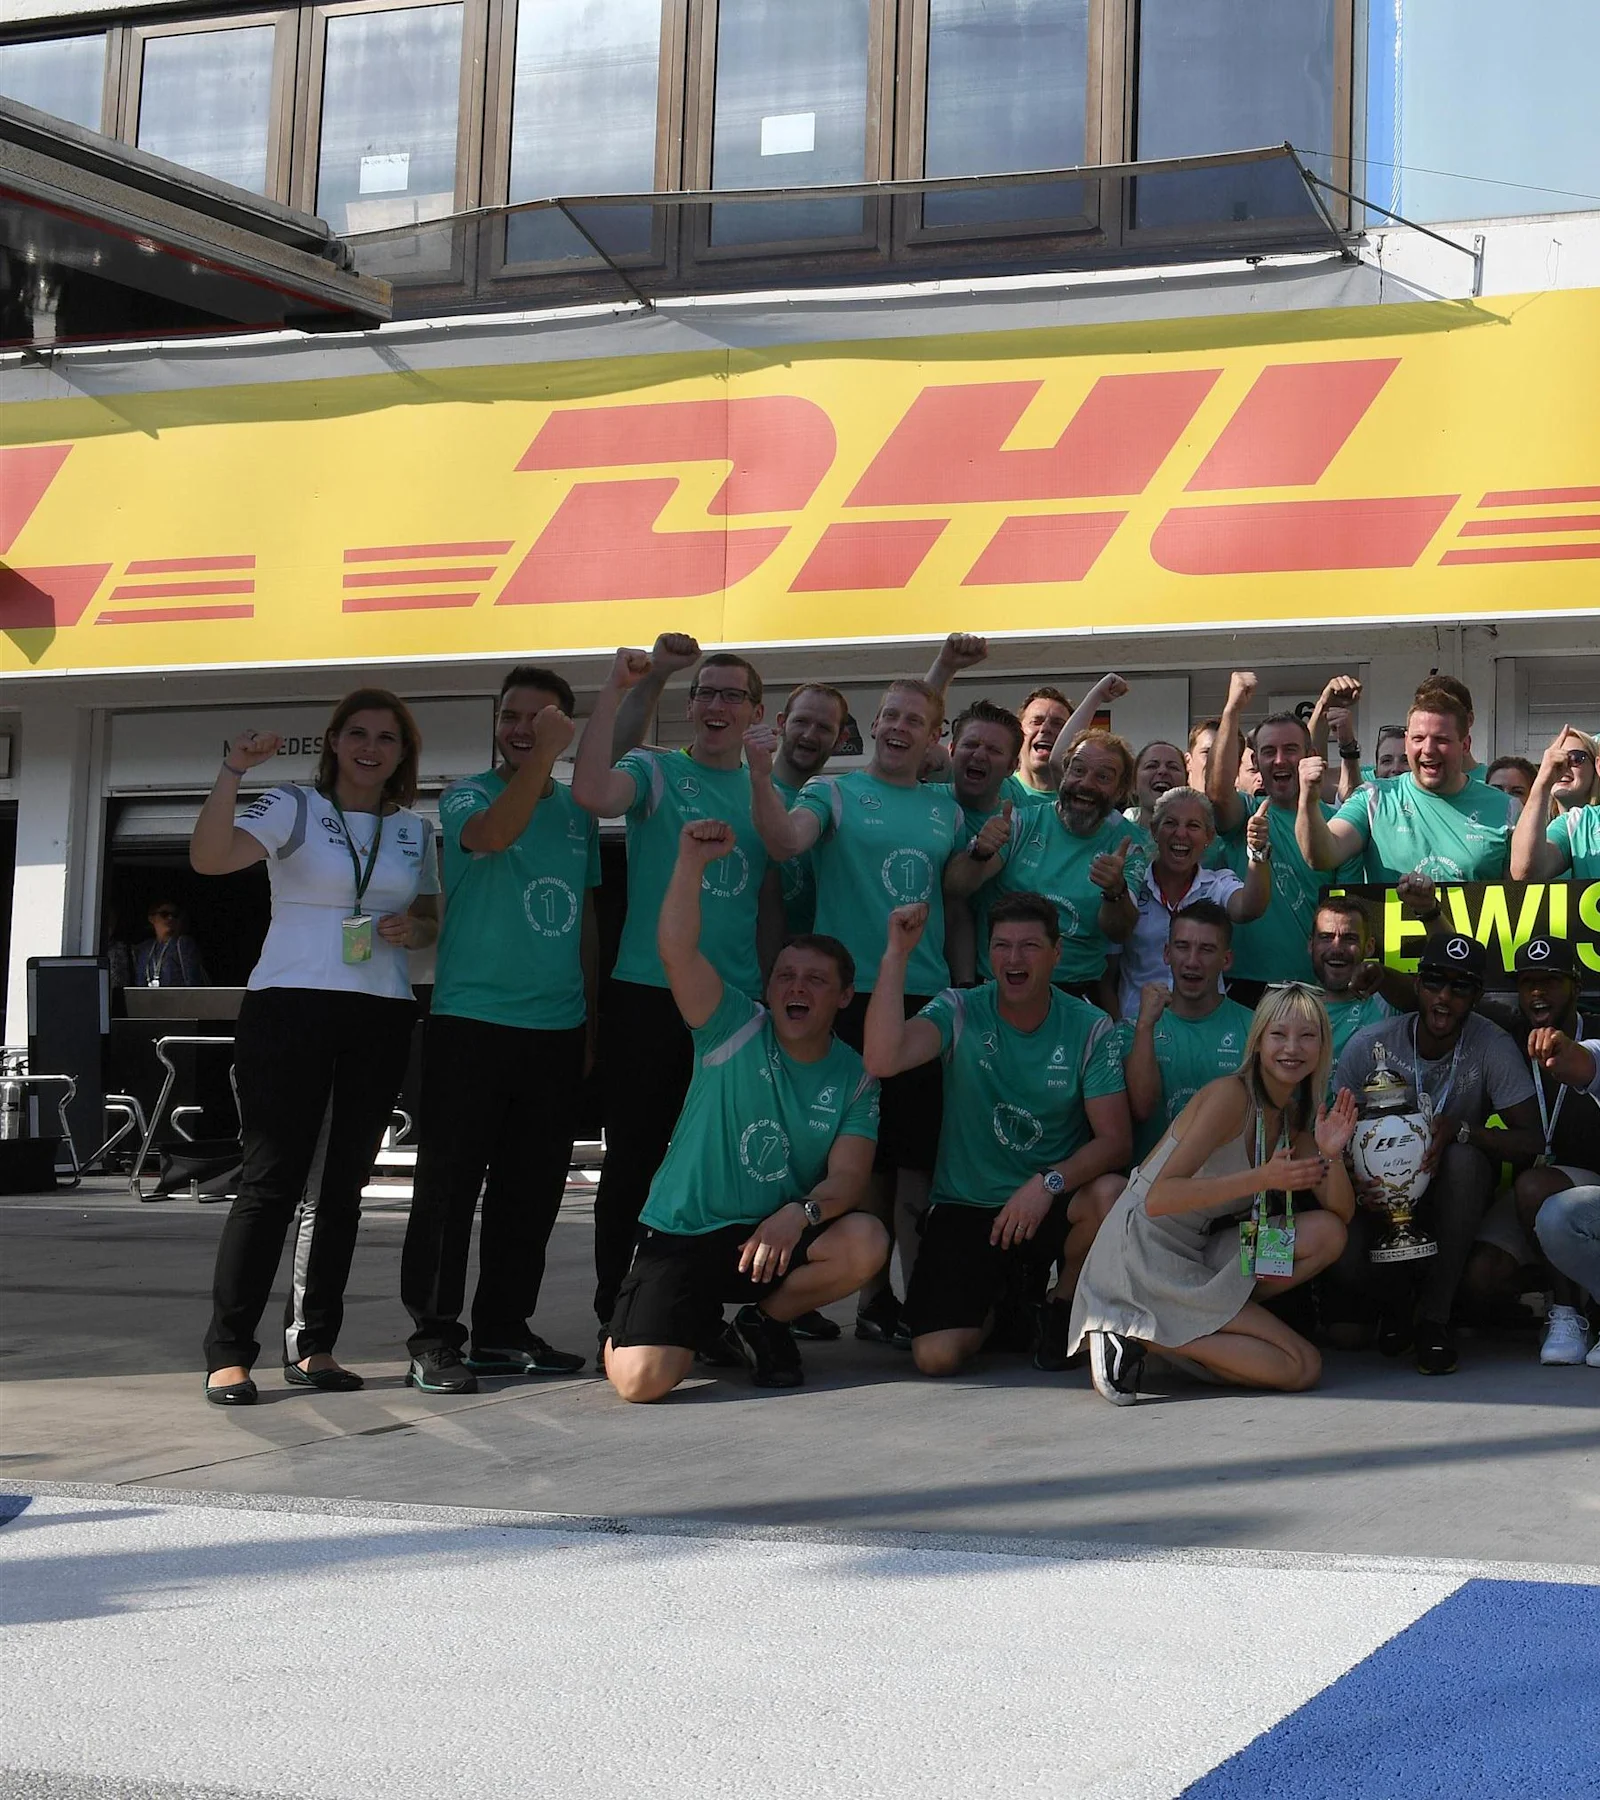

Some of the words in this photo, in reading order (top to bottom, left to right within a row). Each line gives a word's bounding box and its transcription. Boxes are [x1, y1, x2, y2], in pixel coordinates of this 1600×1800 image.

[494, 357, 1461, 606] DHL
[901, 859, 915, 889] 1
[538, 876, 570, 893] WINNERS
[712, 888, 731, 898] 2016
[541, 890, 554, 923] 1
[543, 929, 561, 937] 2016
[758, 1120, 769, 1128] GP
[809, 1120, 830, 1130] BOSS
[747, 1167, 765, 1182] 2016
